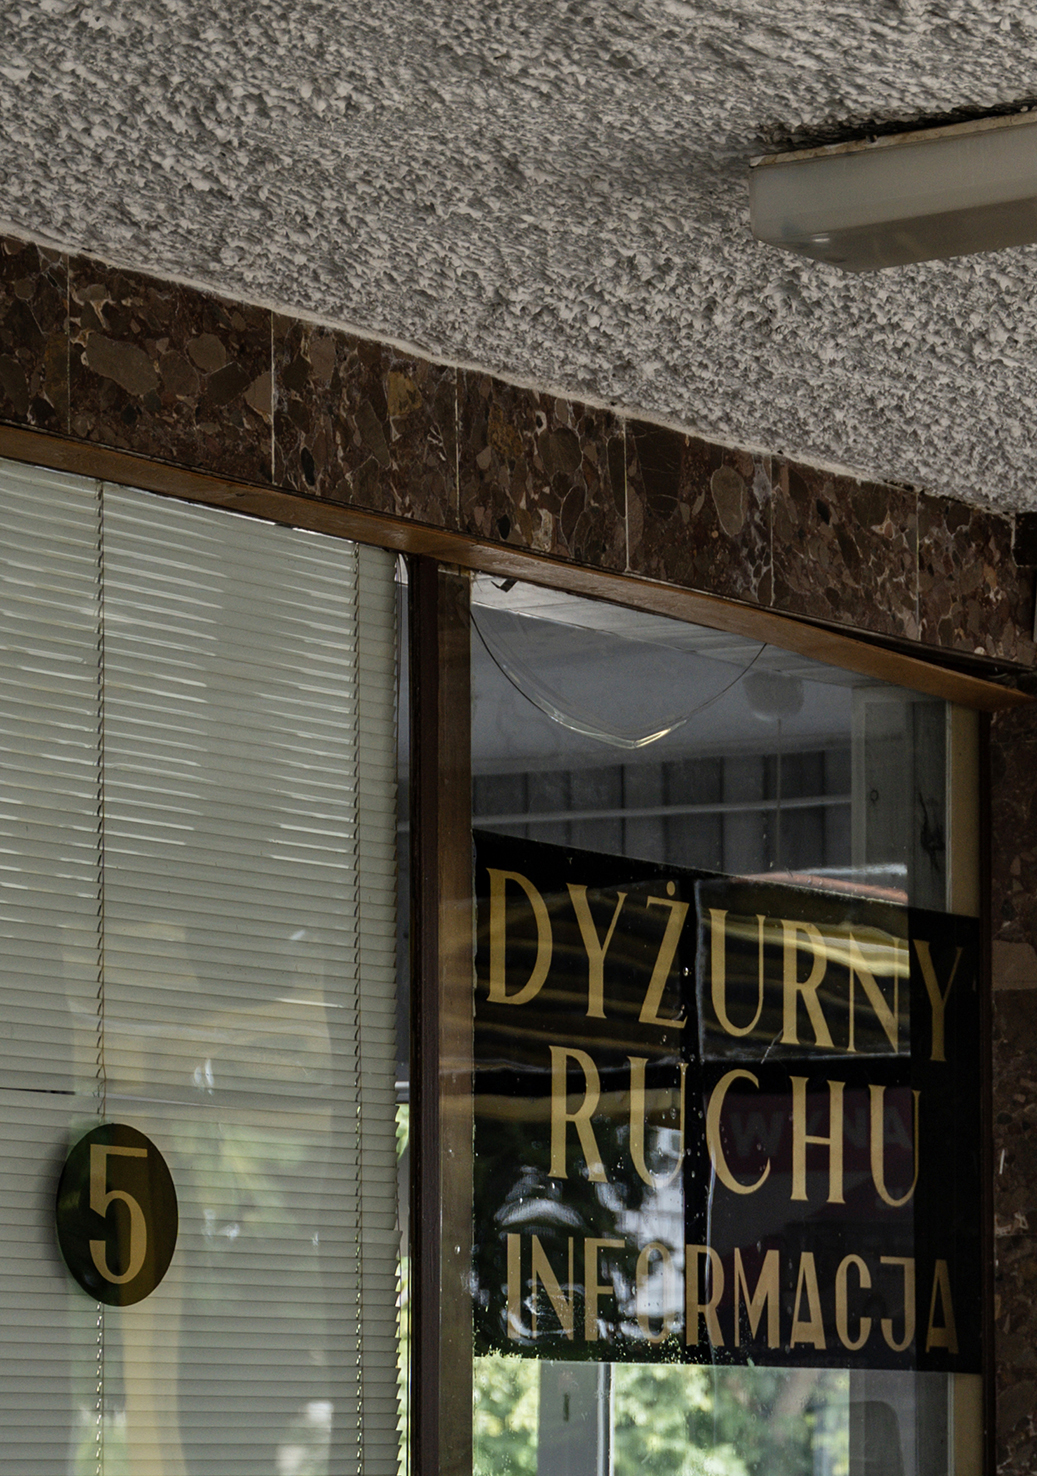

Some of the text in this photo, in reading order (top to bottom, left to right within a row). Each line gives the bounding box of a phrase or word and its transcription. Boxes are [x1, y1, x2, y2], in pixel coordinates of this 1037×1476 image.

[486, 867, 964, 1062] DYŻURNY
[548, 1045, 922, 1207] RUCHU
[89, 1143, 148, 1285] 5
[505, 1232, 960, 1354] INFORMACJA
